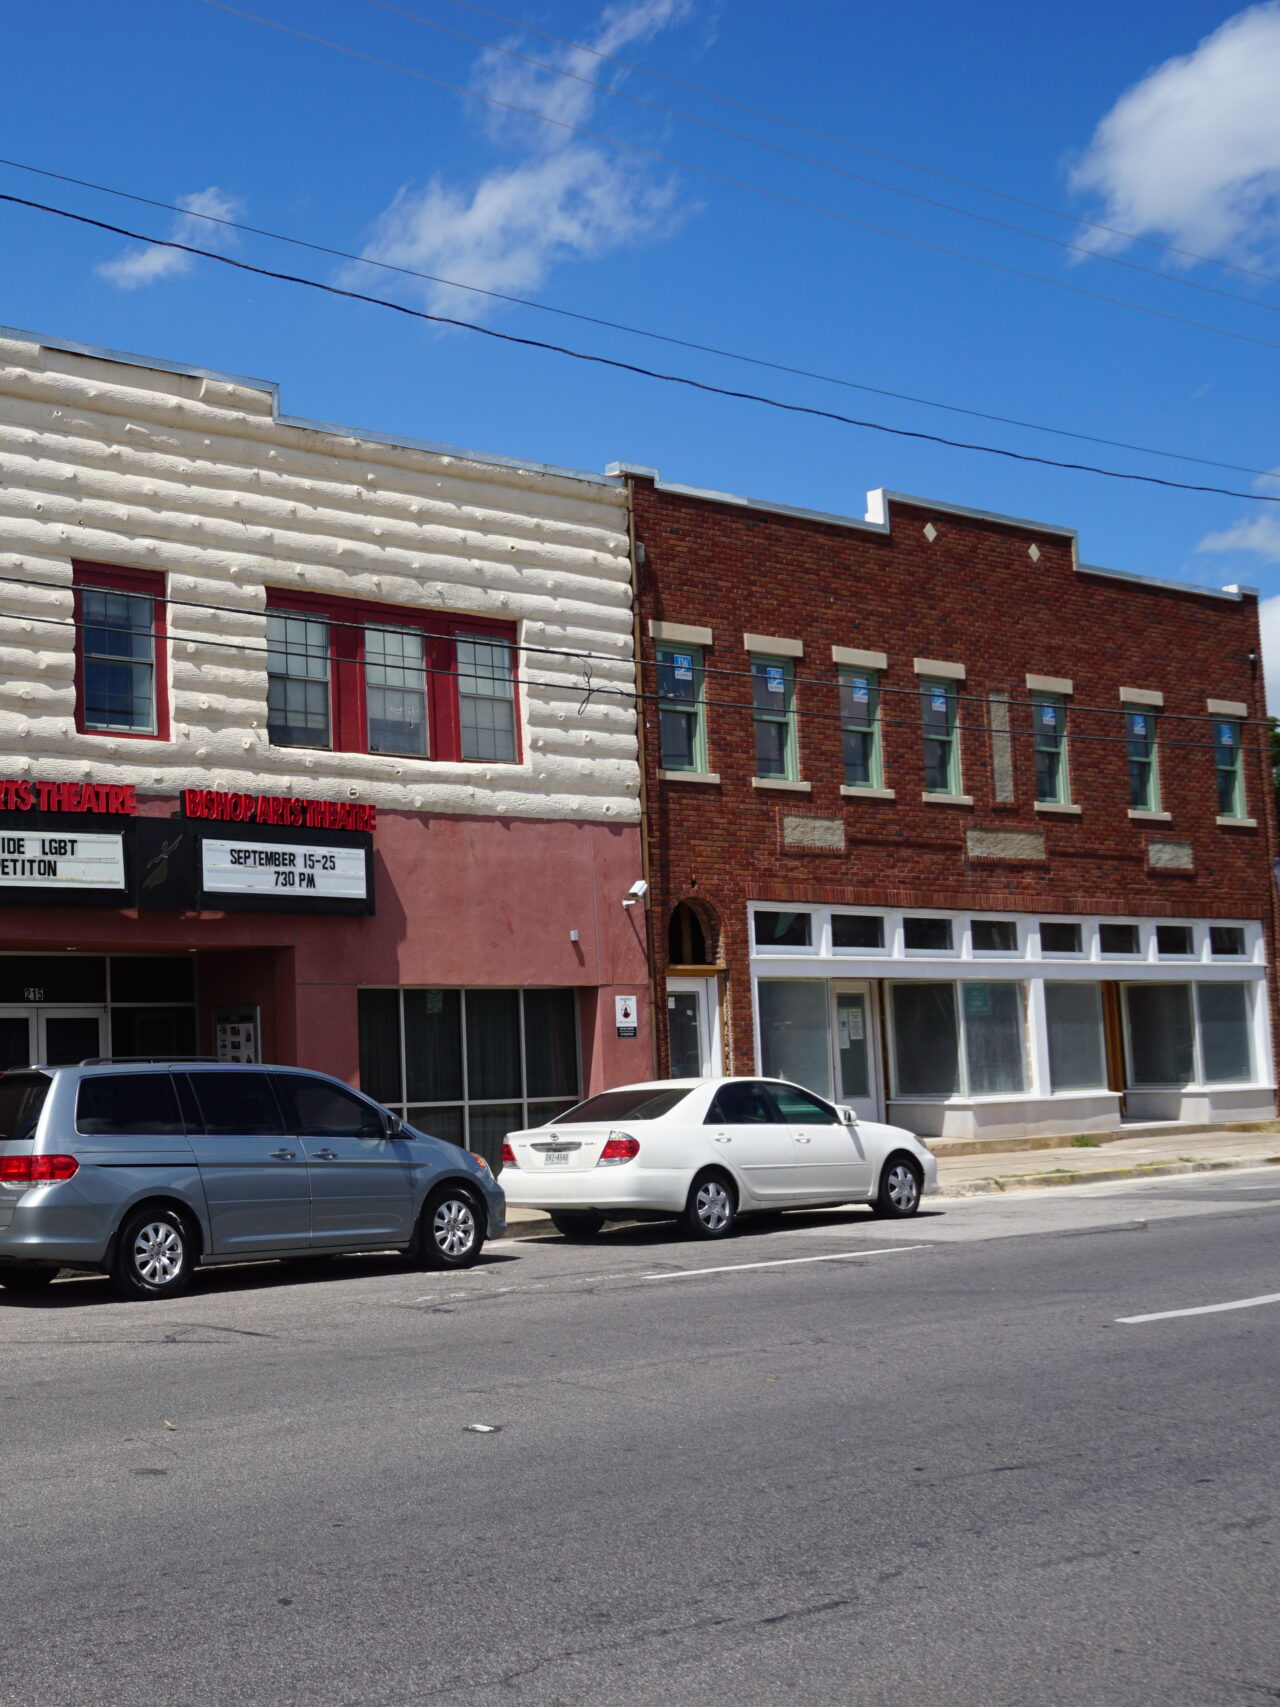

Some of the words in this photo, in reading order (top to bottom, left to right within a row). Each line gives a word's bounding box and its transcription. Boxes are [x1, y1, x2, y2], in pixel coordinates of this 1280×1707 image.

[36, 781, 137, 814] THEATRE
[185, 788, 255, 822] BISHOP
[256, 796, 303, 826] ARTS
[304, 800, 376, 831] THEATRE
[41, 839, 77, 856] LGBT
[230, 849, 295, 867] SEPTEMBER
[303, 853, 336, 870] 15-25
[274, 871, 295, 886] 730
[299, 873, 315, 889] PM
[25, 988, 43, 1000] 215
